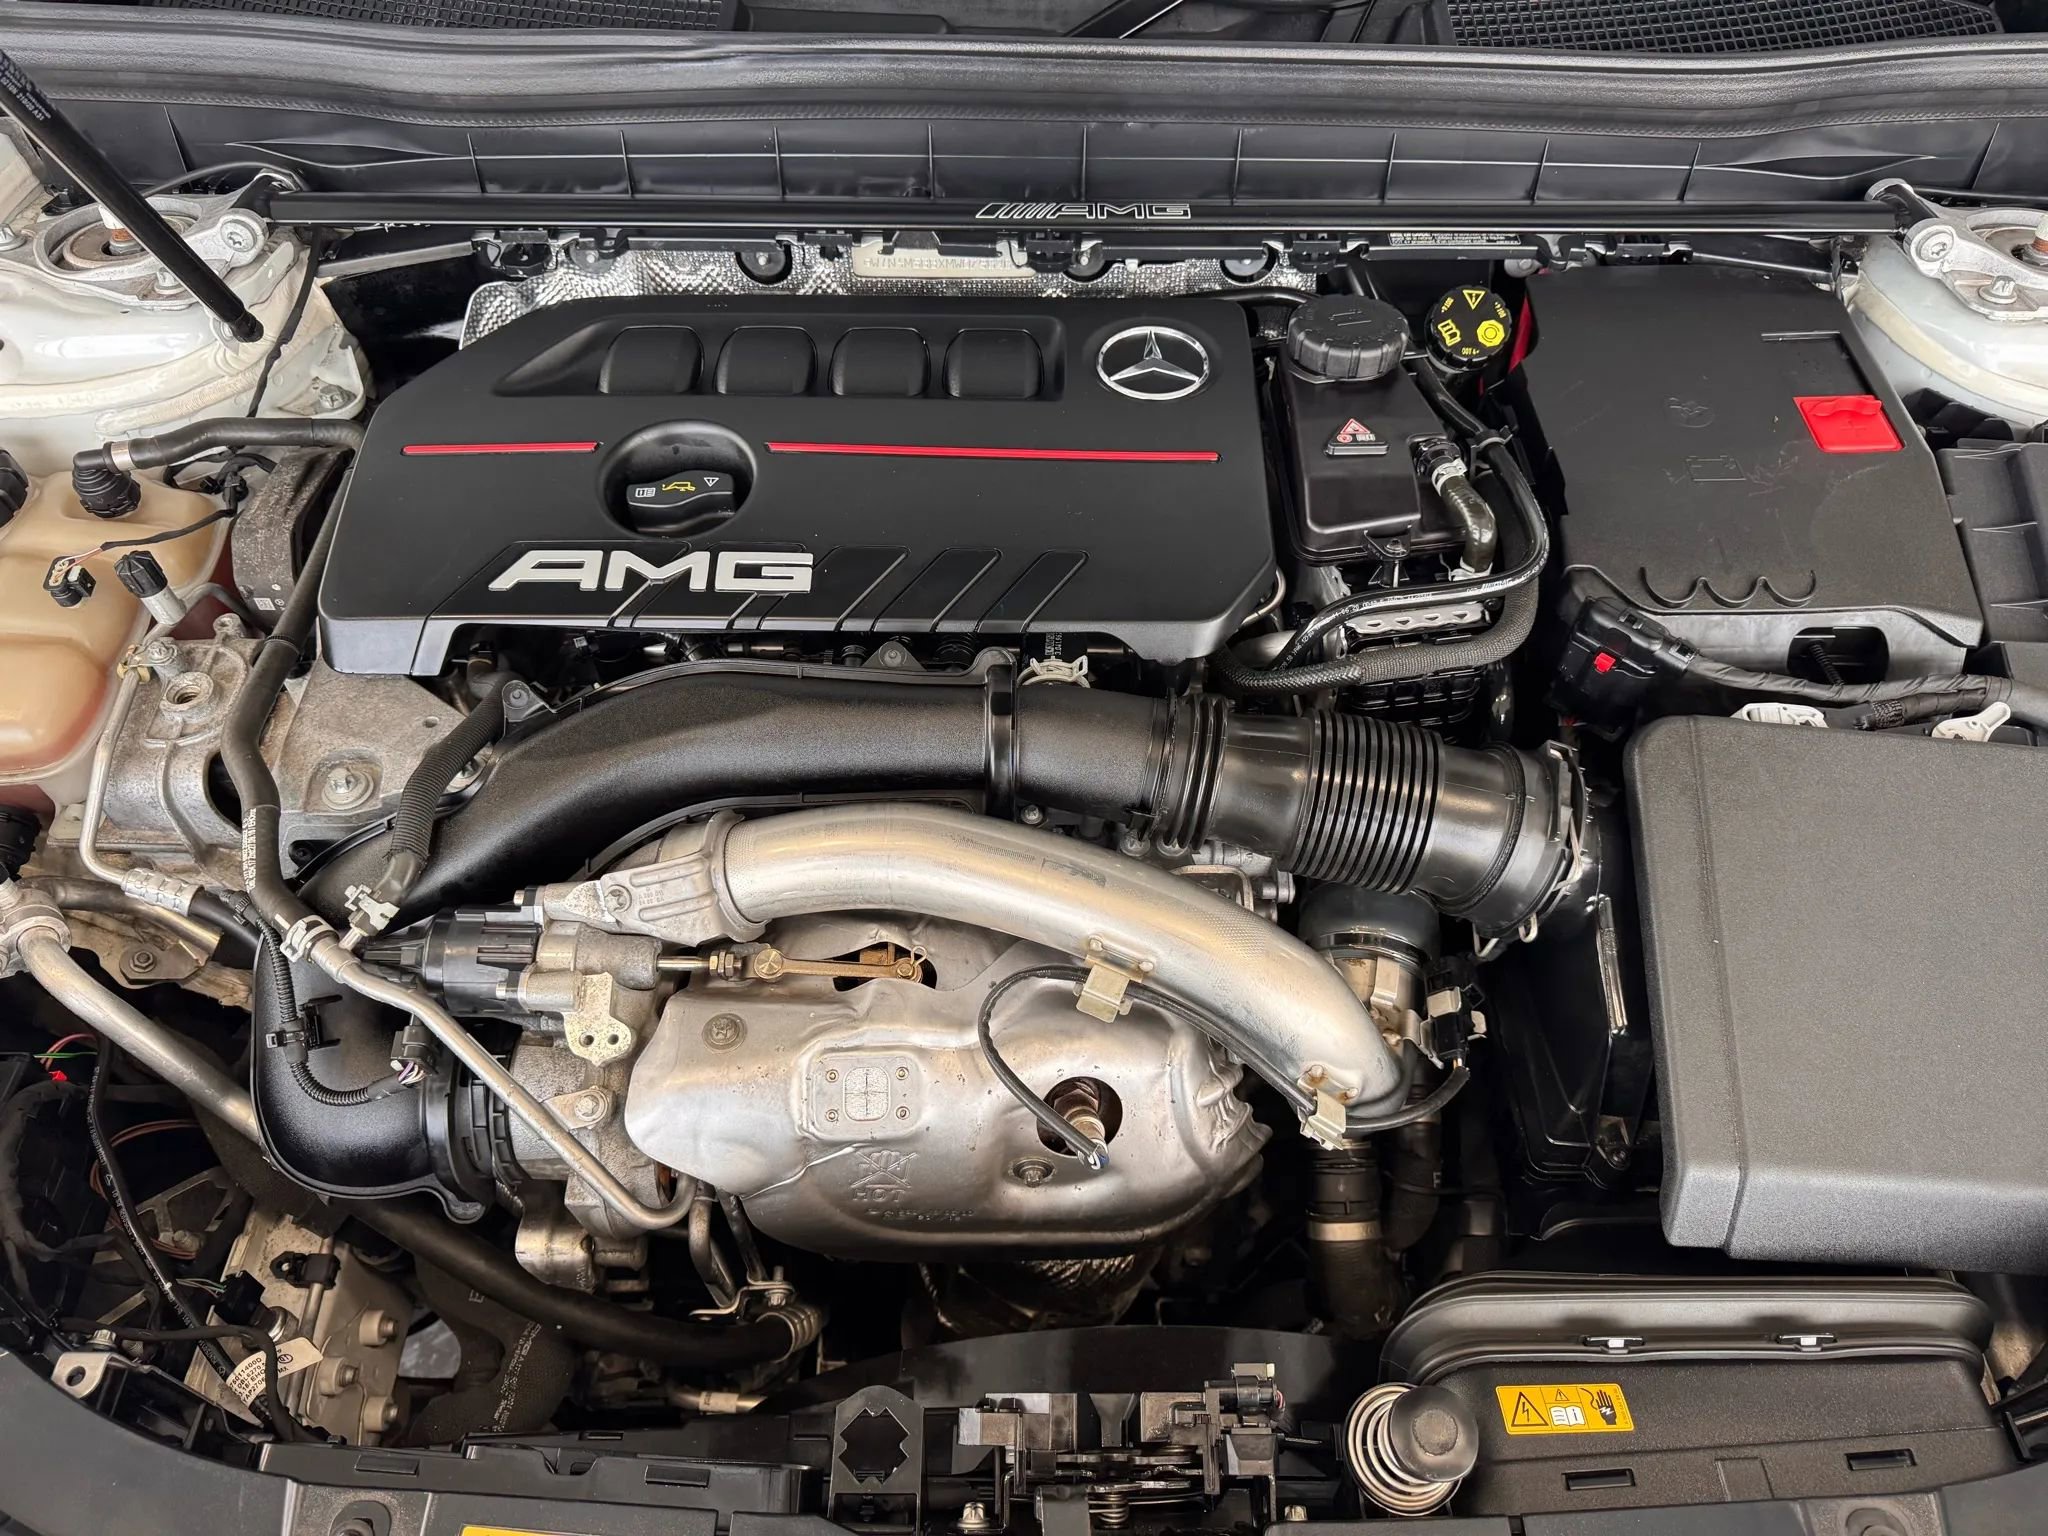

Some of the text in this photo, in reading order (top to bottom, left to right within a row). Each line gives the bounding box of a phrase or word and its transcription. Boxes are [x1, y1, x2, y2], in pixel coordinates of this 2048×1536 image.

[1046, 203, 1191, 219] AMG
[488, 550, 814, 592] AMG
[852, 1188, 906, 1202] HOT
